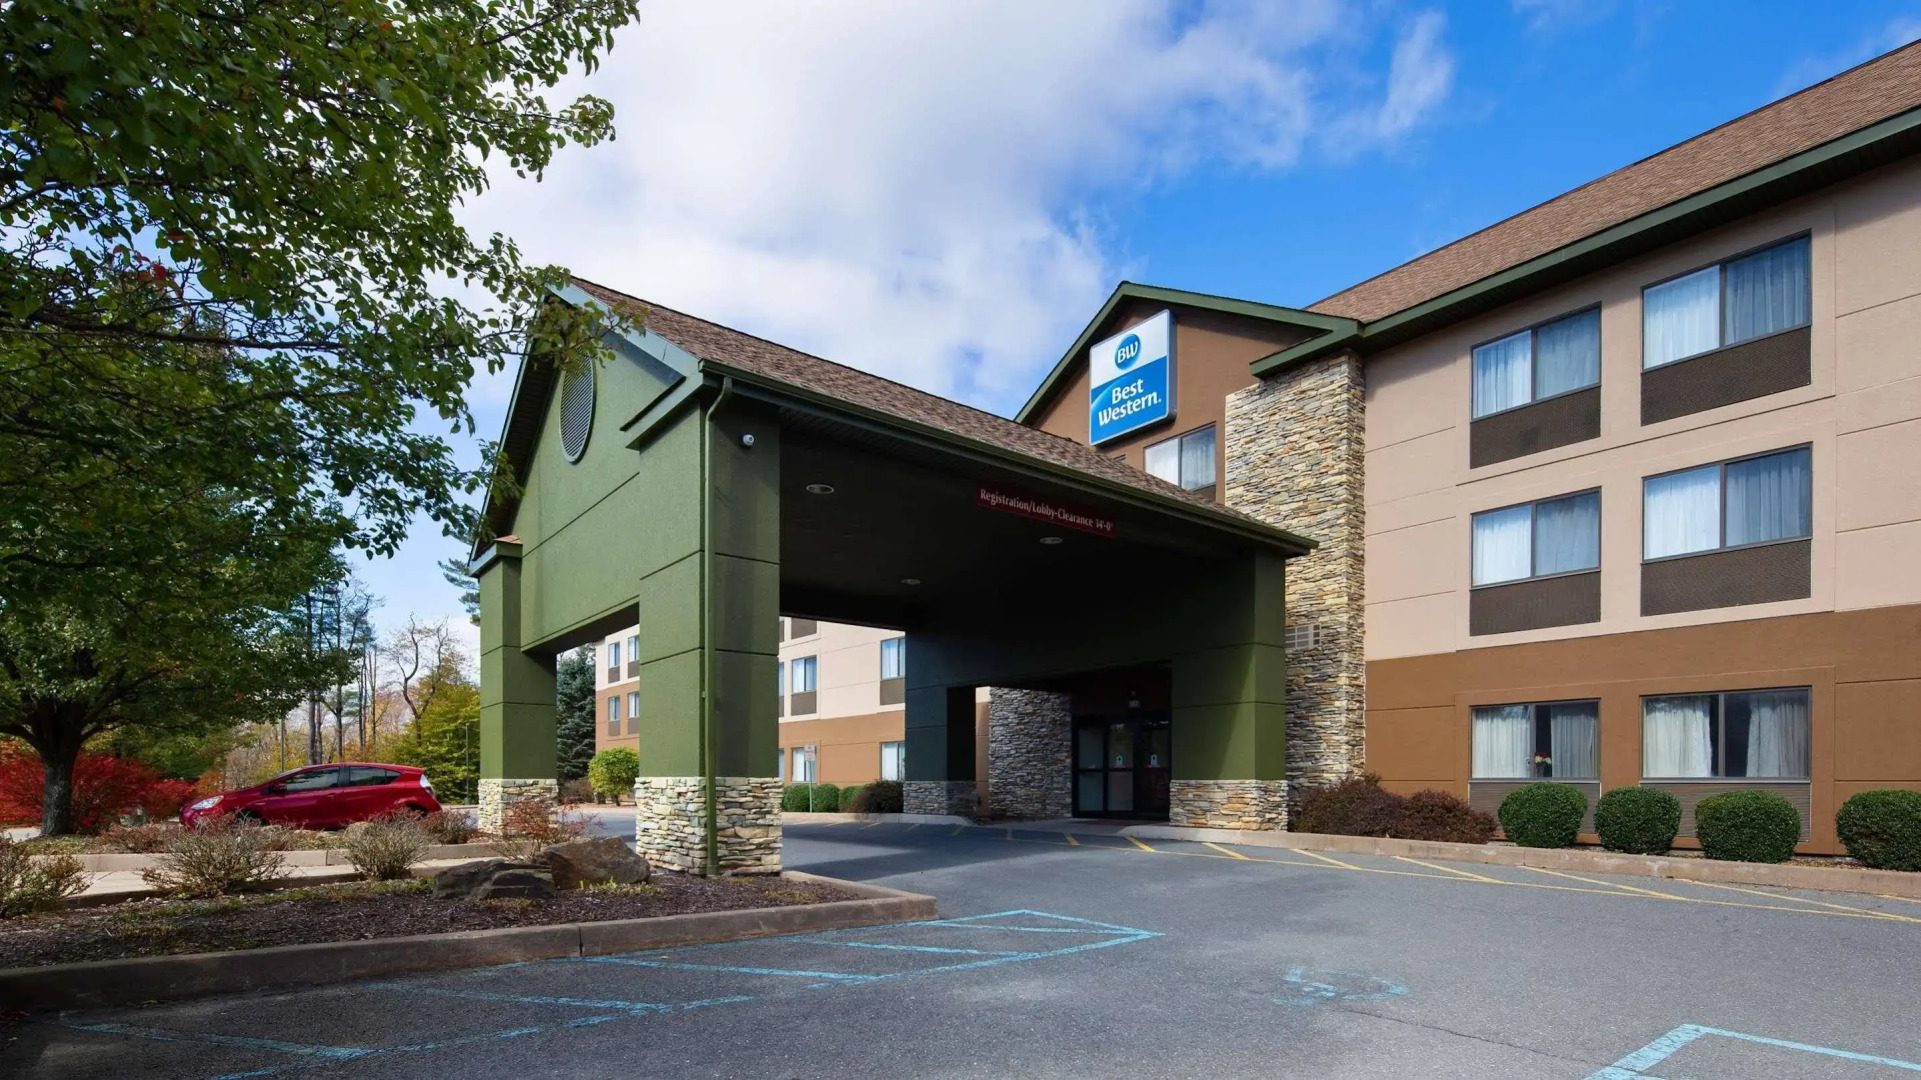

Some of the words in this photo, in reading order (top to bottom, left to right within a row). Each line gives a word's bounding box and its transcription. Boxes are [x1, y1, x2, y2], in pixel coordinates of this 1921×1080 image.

[1117, 341, 1139, 364] BW
[1111, 378, 1144, 405] Best
[980, 488, 1093, 527] Registration/Lobby-Clearance
